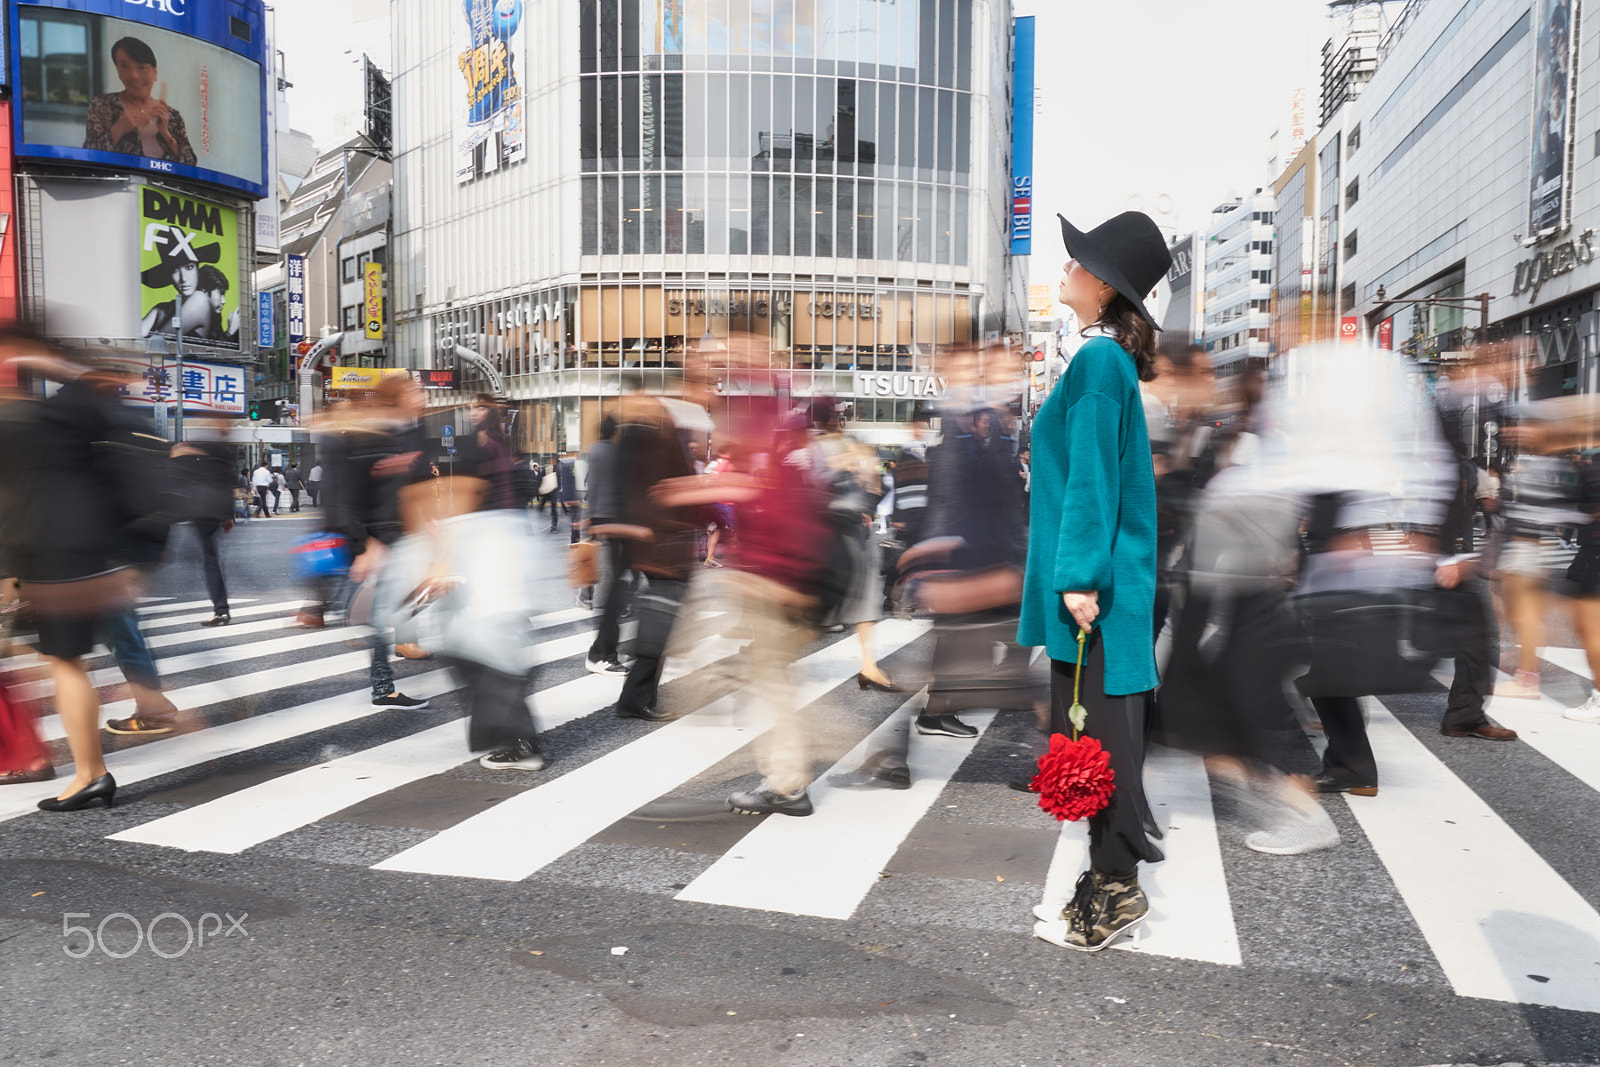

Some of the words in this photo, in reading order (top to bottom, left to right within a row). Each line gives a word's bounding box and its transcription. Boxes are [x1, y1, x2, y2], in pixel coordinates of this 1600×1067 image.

[150, 160, 173, 172] DHC
[142, 188, 224, 237] DMM
[1013, 176, 1031, 241] SEIBU
[143, 222, 199, 262] FX
[289, 259, 304, 336] 洋服の青山
[807, 300, 882, 320] COFFEE
[497, 300, 562, 331] TSUTAYA
[860, 374, 949, 397] TSUTAY
